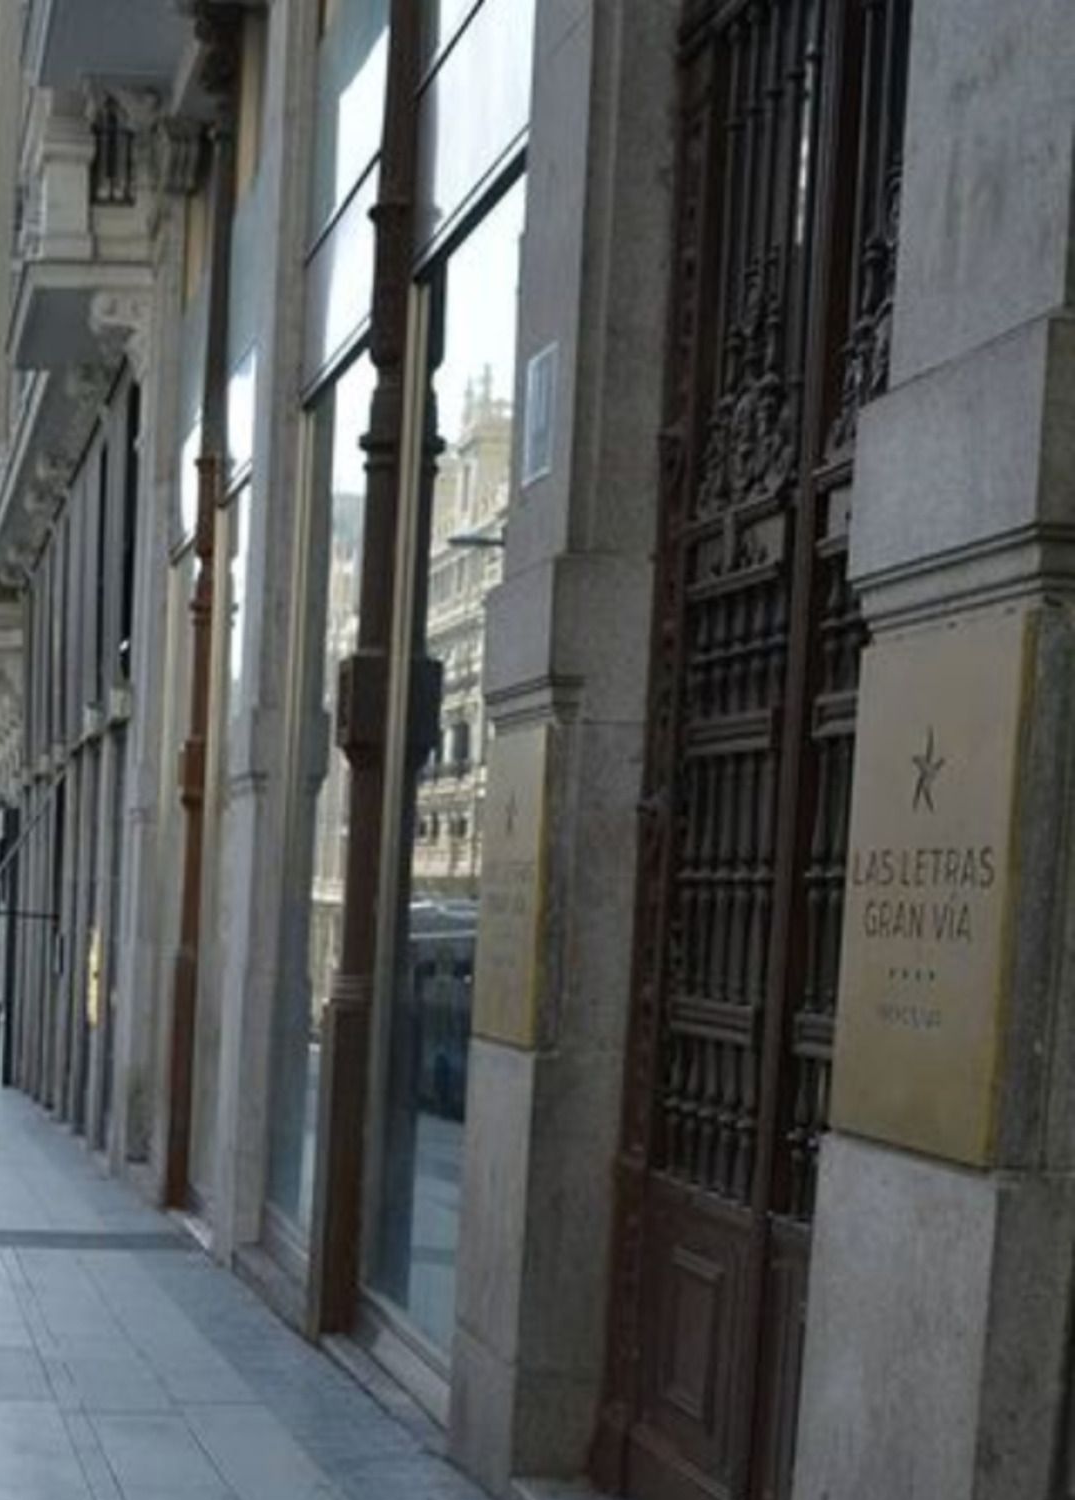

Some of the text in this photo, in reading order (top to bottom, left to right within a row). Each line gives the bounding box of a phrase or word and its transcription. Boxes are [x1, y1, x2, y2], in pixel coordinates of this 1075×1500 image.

[852, 845, 996, 889] LAS LETRAS
[863, 900, 925, 940] GRAN
